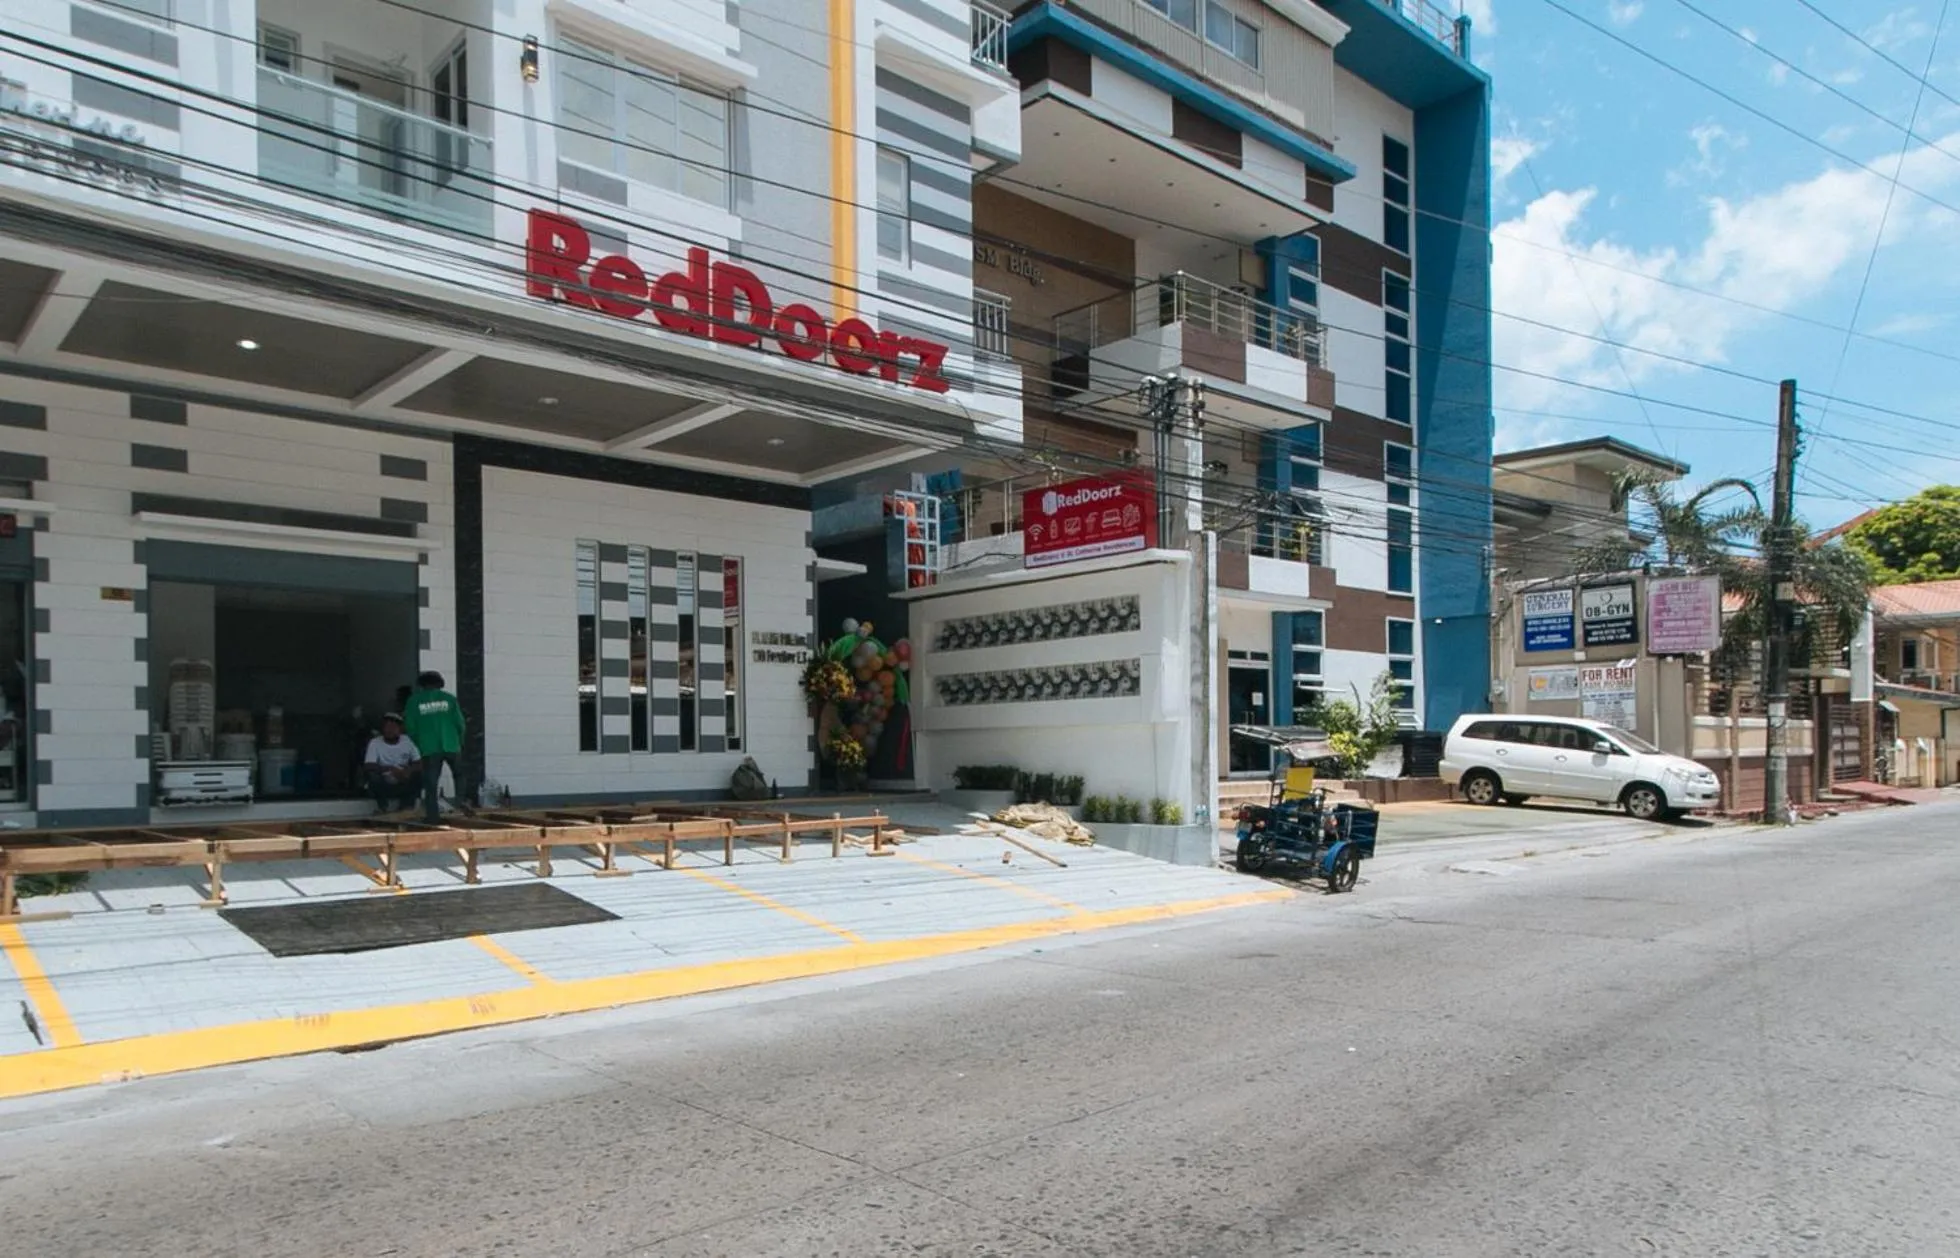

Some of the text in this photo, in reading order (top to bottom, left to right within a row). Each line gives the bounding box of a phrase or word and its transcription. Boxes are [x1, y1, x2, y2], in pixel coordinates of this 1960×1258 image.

[526, 208, 950, 395] RedDoorz
[1057, 485, 1122, 508] RedDoorz
[1526, 593, 1570, 603] GENERAL
[1585, 603, 1630, 617] OB-GYN
[1582, 667, 1633, 681] FOR RENT
